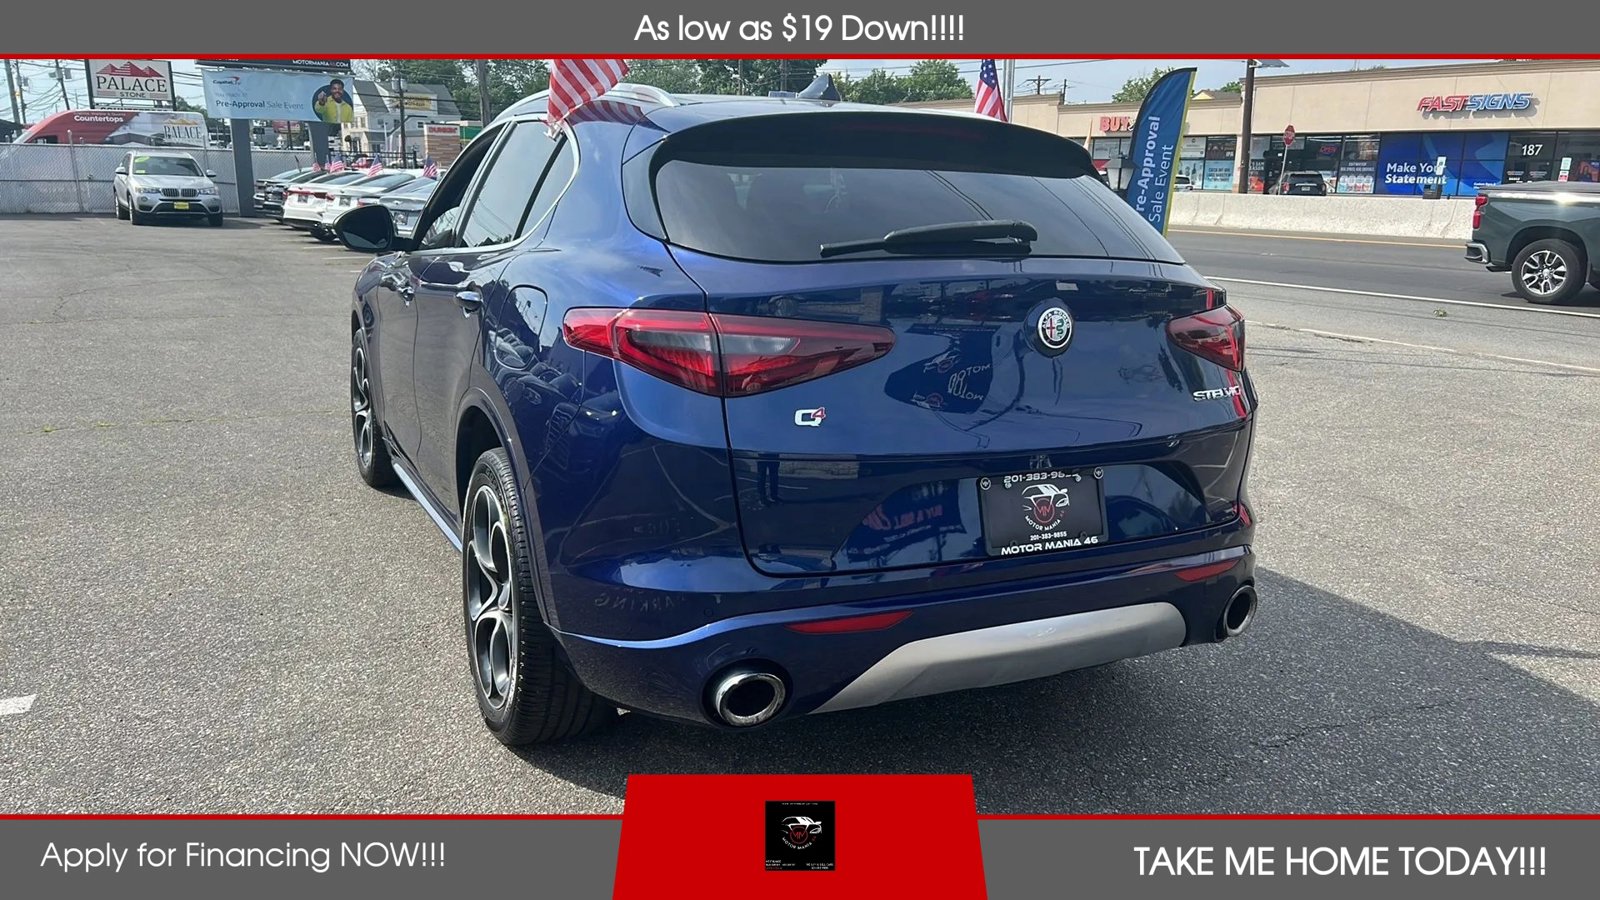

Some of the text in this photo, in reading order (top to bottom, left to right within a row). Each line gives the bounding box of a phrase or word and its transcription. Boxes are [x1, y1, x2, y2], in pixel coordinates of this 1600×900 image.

[95, 75, 167, 93] PALACE
[216, 100, 265, 108] Pre-Approval
[283, 102, 304, 110] Event
[1416, 92, 1533, 112] FASTSIGNS
[74, 115, 124, 123] Countertops
[1100, 116, 1129, 132] BUY
[163, 125, 201, 139] PALACE
[1521, 144, 1544, 156] 187
[1136, 115, 1161, 213] re-Approval
[1386, 162, 1417, 173] Make
[1149, 144, 1174, 223] Sale Event
[1385, 173, 1447, 184] Statement
[794, 406, 826, 427] Q4
[1024, 515, 1061, 531] MOTOR MANIA
[1001, 536, 1099, 555] MOTOR MANIA 46
